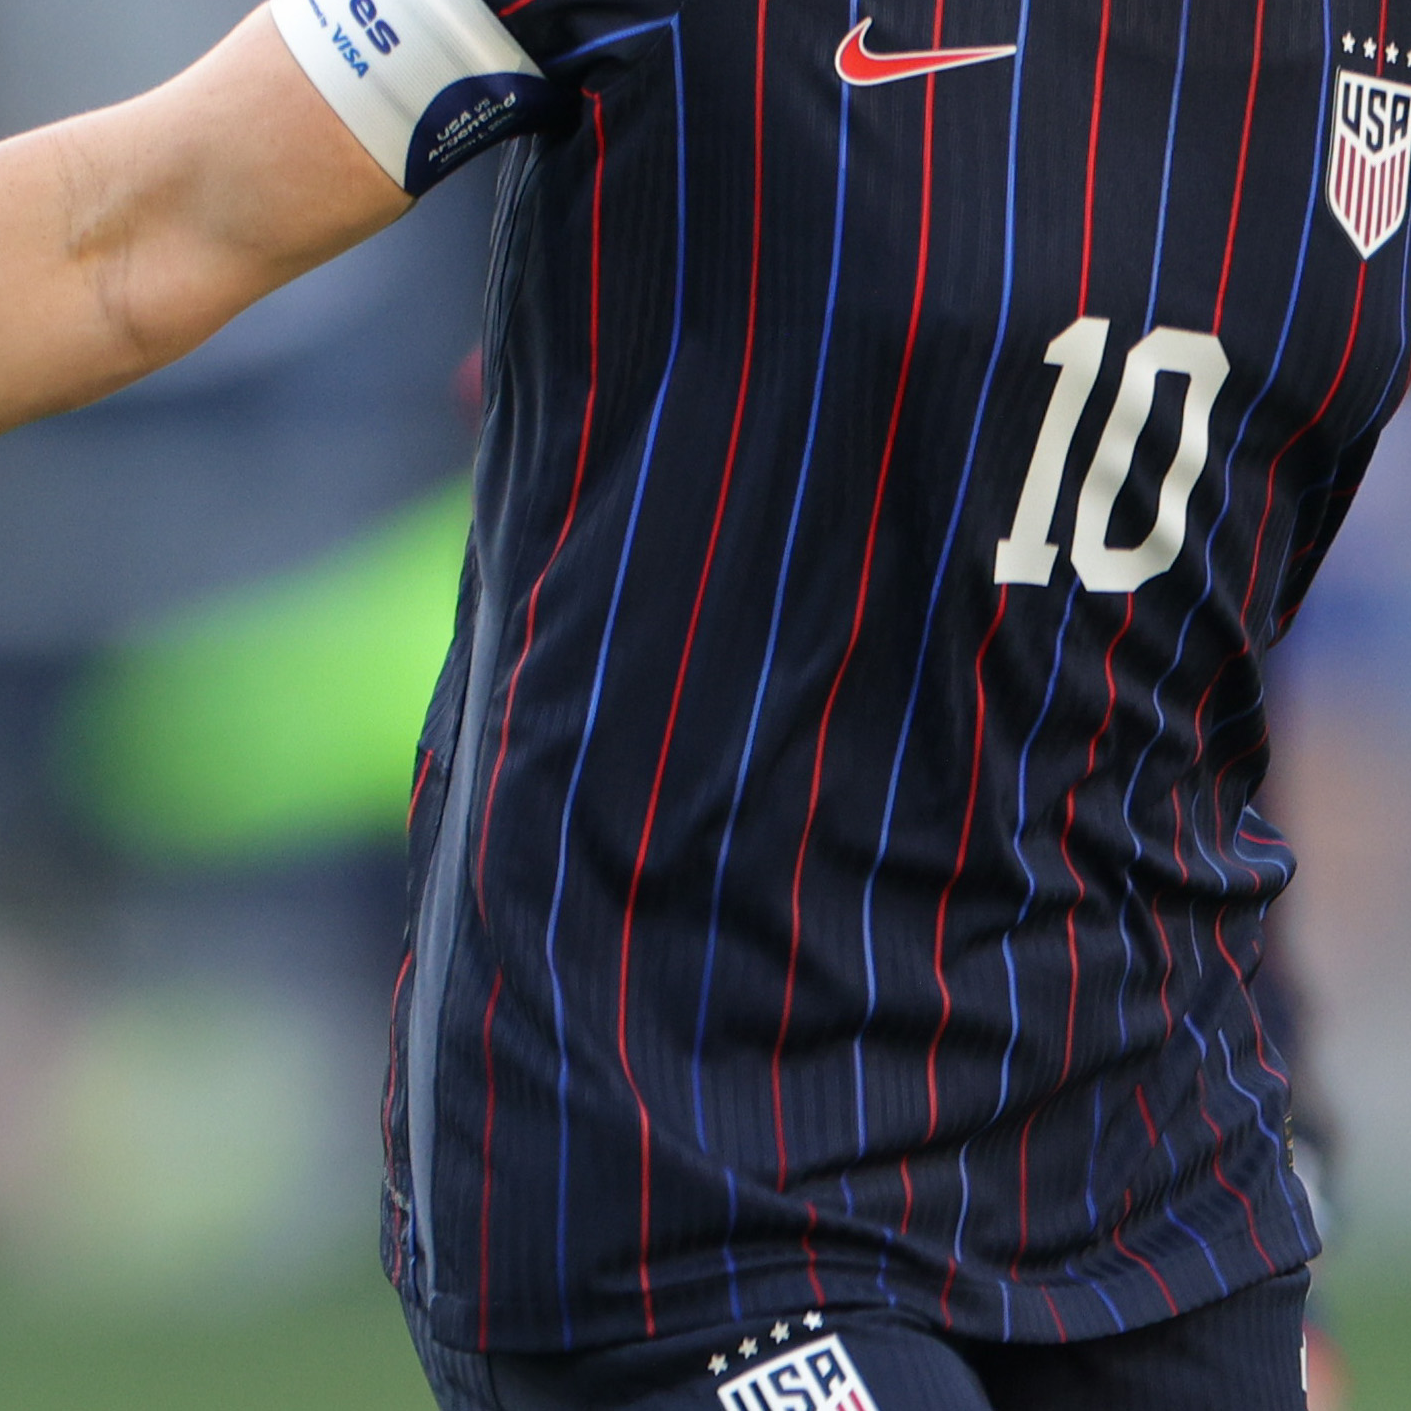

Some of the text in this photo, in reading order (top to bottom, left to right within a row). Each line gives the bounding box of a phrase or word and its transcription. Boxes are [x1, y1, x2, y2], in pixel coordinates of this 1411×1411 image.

[331, 22, 370, 79] VISA
[436, 111, 472, 142] USA
[1342, 81, 1411, 155] USA
[993, 315, 1231, 593] 10
